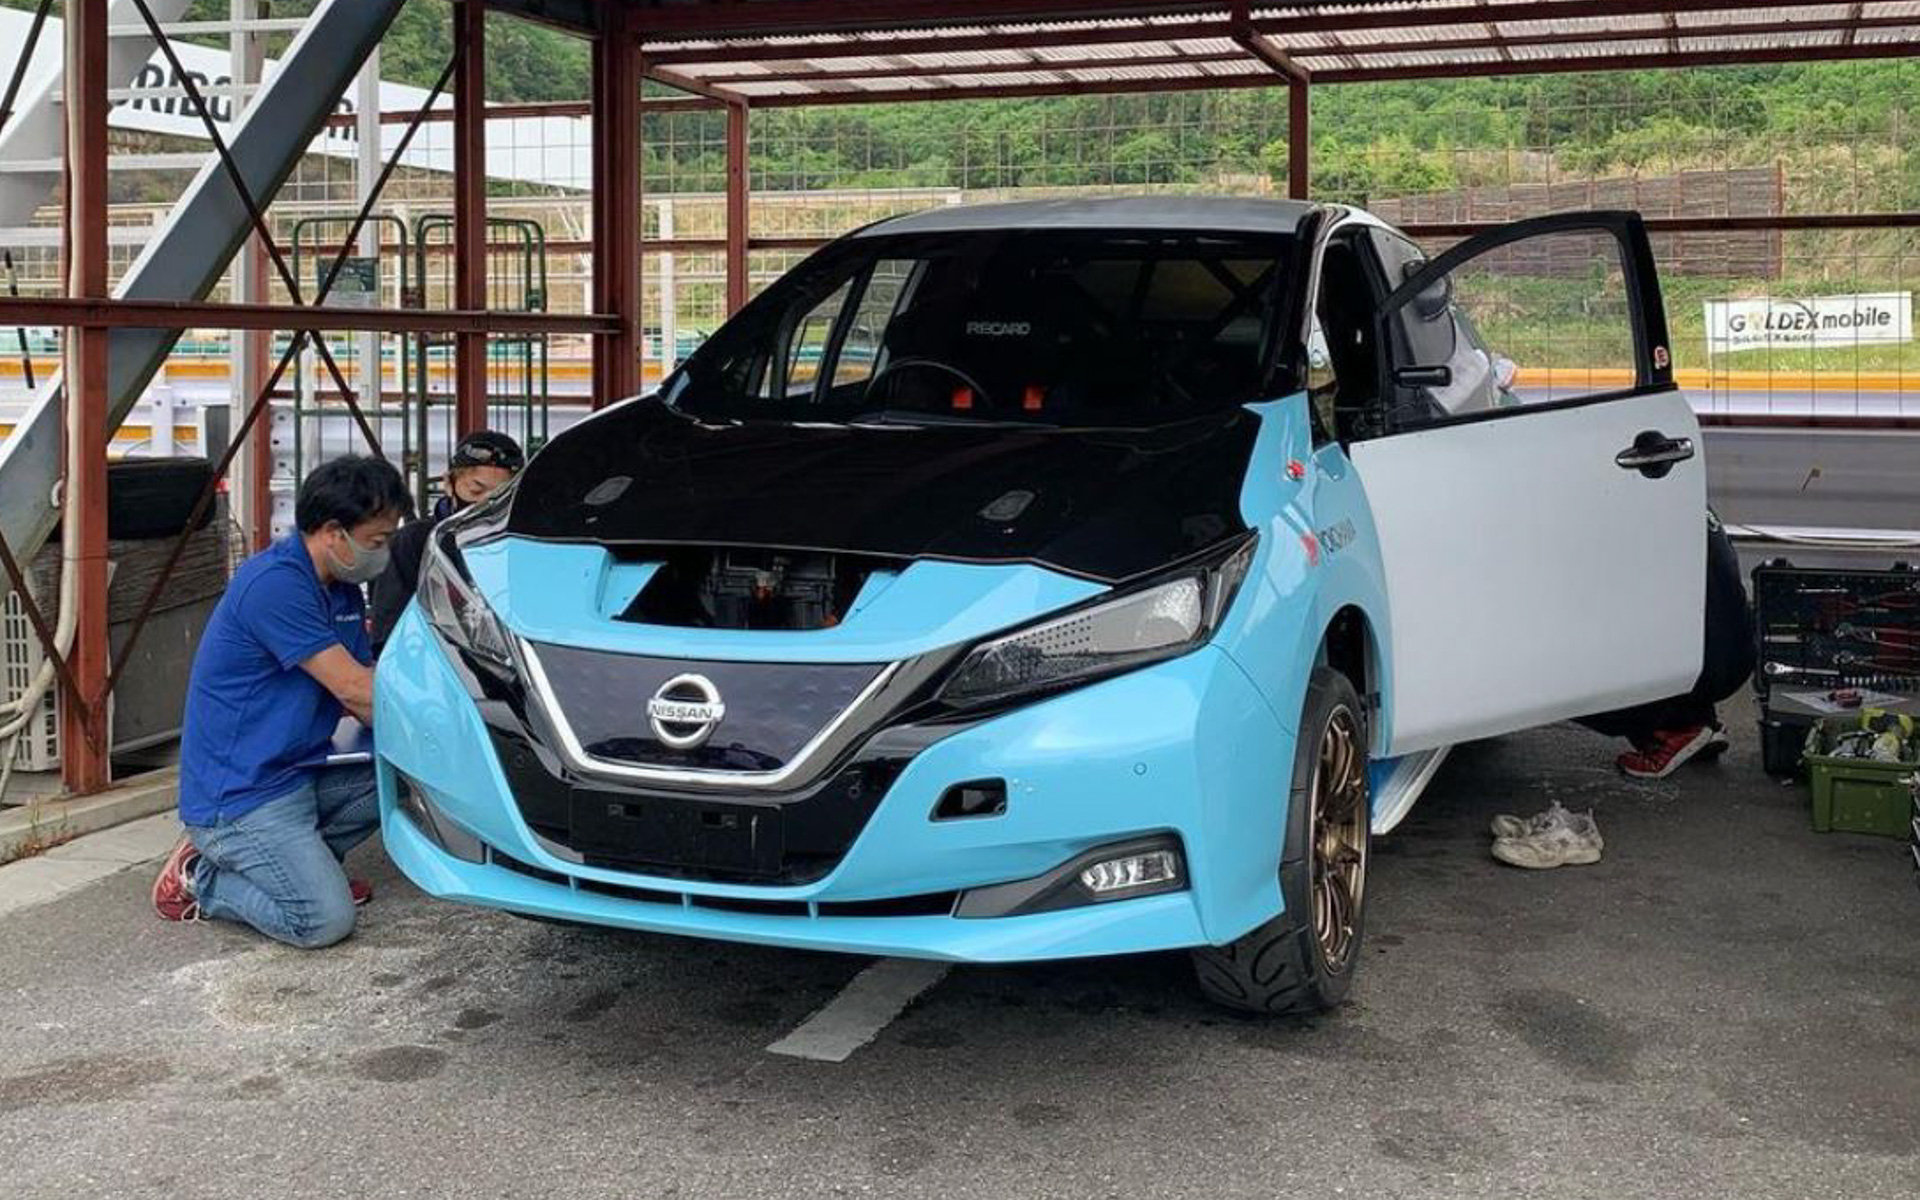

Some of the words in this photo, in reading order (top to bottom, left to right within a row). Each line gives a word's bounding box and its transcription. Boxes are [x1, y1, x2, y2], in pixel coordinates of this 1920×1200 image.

[1824, 306, 1891, 328] mobile
[966, 321, 1032, 336] RECARO
[652, 704, 713, 720] NISSAN
